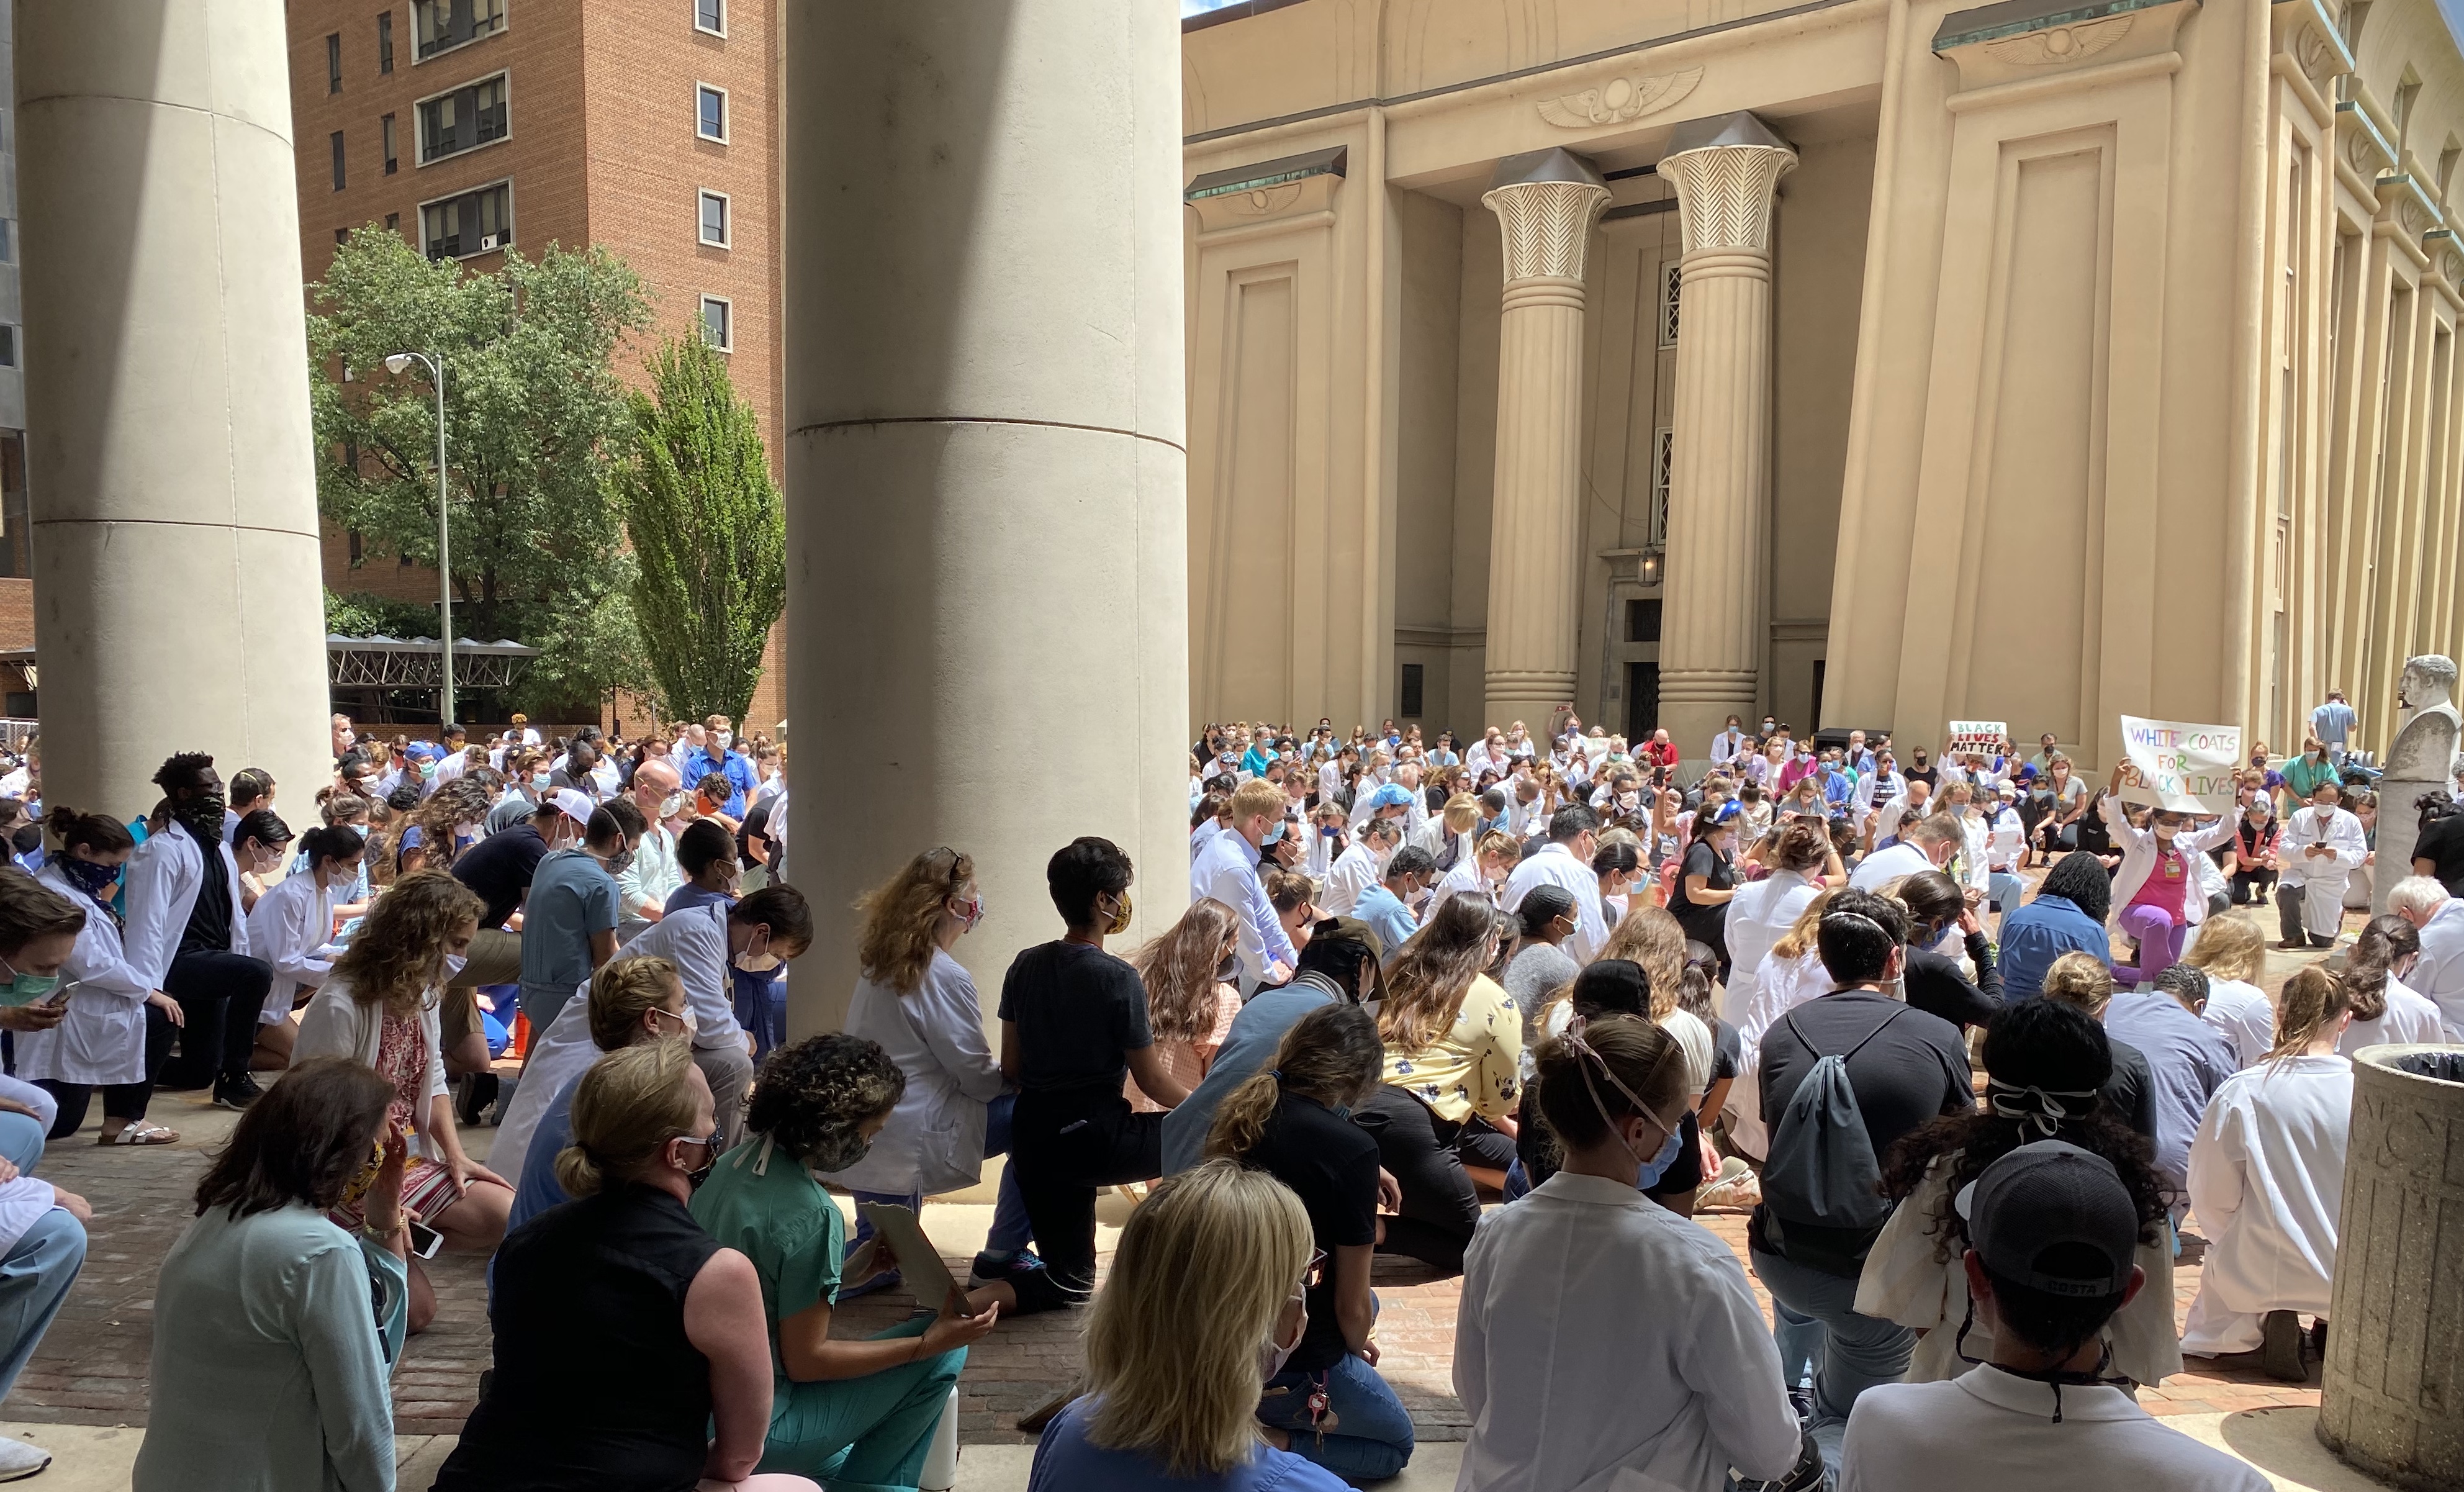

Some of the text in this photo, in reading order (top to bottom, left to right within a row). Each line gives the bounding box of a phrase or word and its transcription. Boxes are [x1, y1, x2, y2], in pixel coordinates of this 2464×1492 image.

[1957, 723, 2001, 733] BLACK
[1958, 733, 2000, 743] LIVES
[2131, 728, 2236, 751] WHITE COATS
[1950, 742, 2003, 755] MATTER
[2158, 754, 2193, 772] FOR
[2124, 765, 2235, 796] BLACK LIVES
[2048, 1280, 2096, 1294] COSTA
